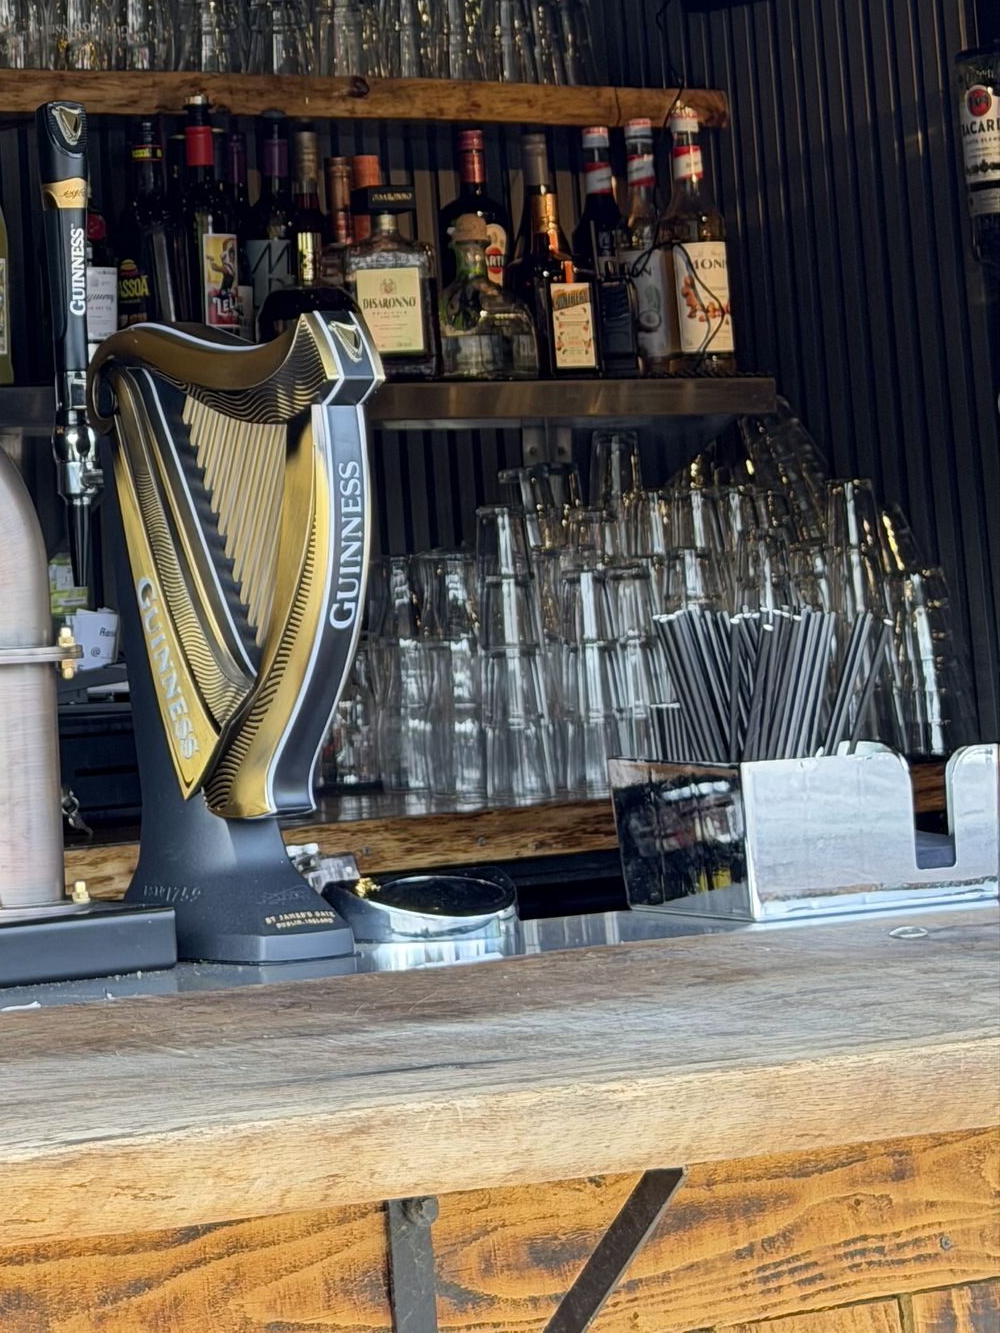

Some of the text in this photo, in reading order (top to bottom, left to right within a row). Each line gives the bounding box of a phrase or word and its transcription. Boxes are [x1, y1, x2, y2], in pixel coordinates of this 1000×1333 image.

[70, 227, 86, 316] GUINNESS
[362, 296, 417, 309] DISARONNO
[328, 461, 362, 630] GUINNESS
[137, 576, 199, 760] GUINNESS
